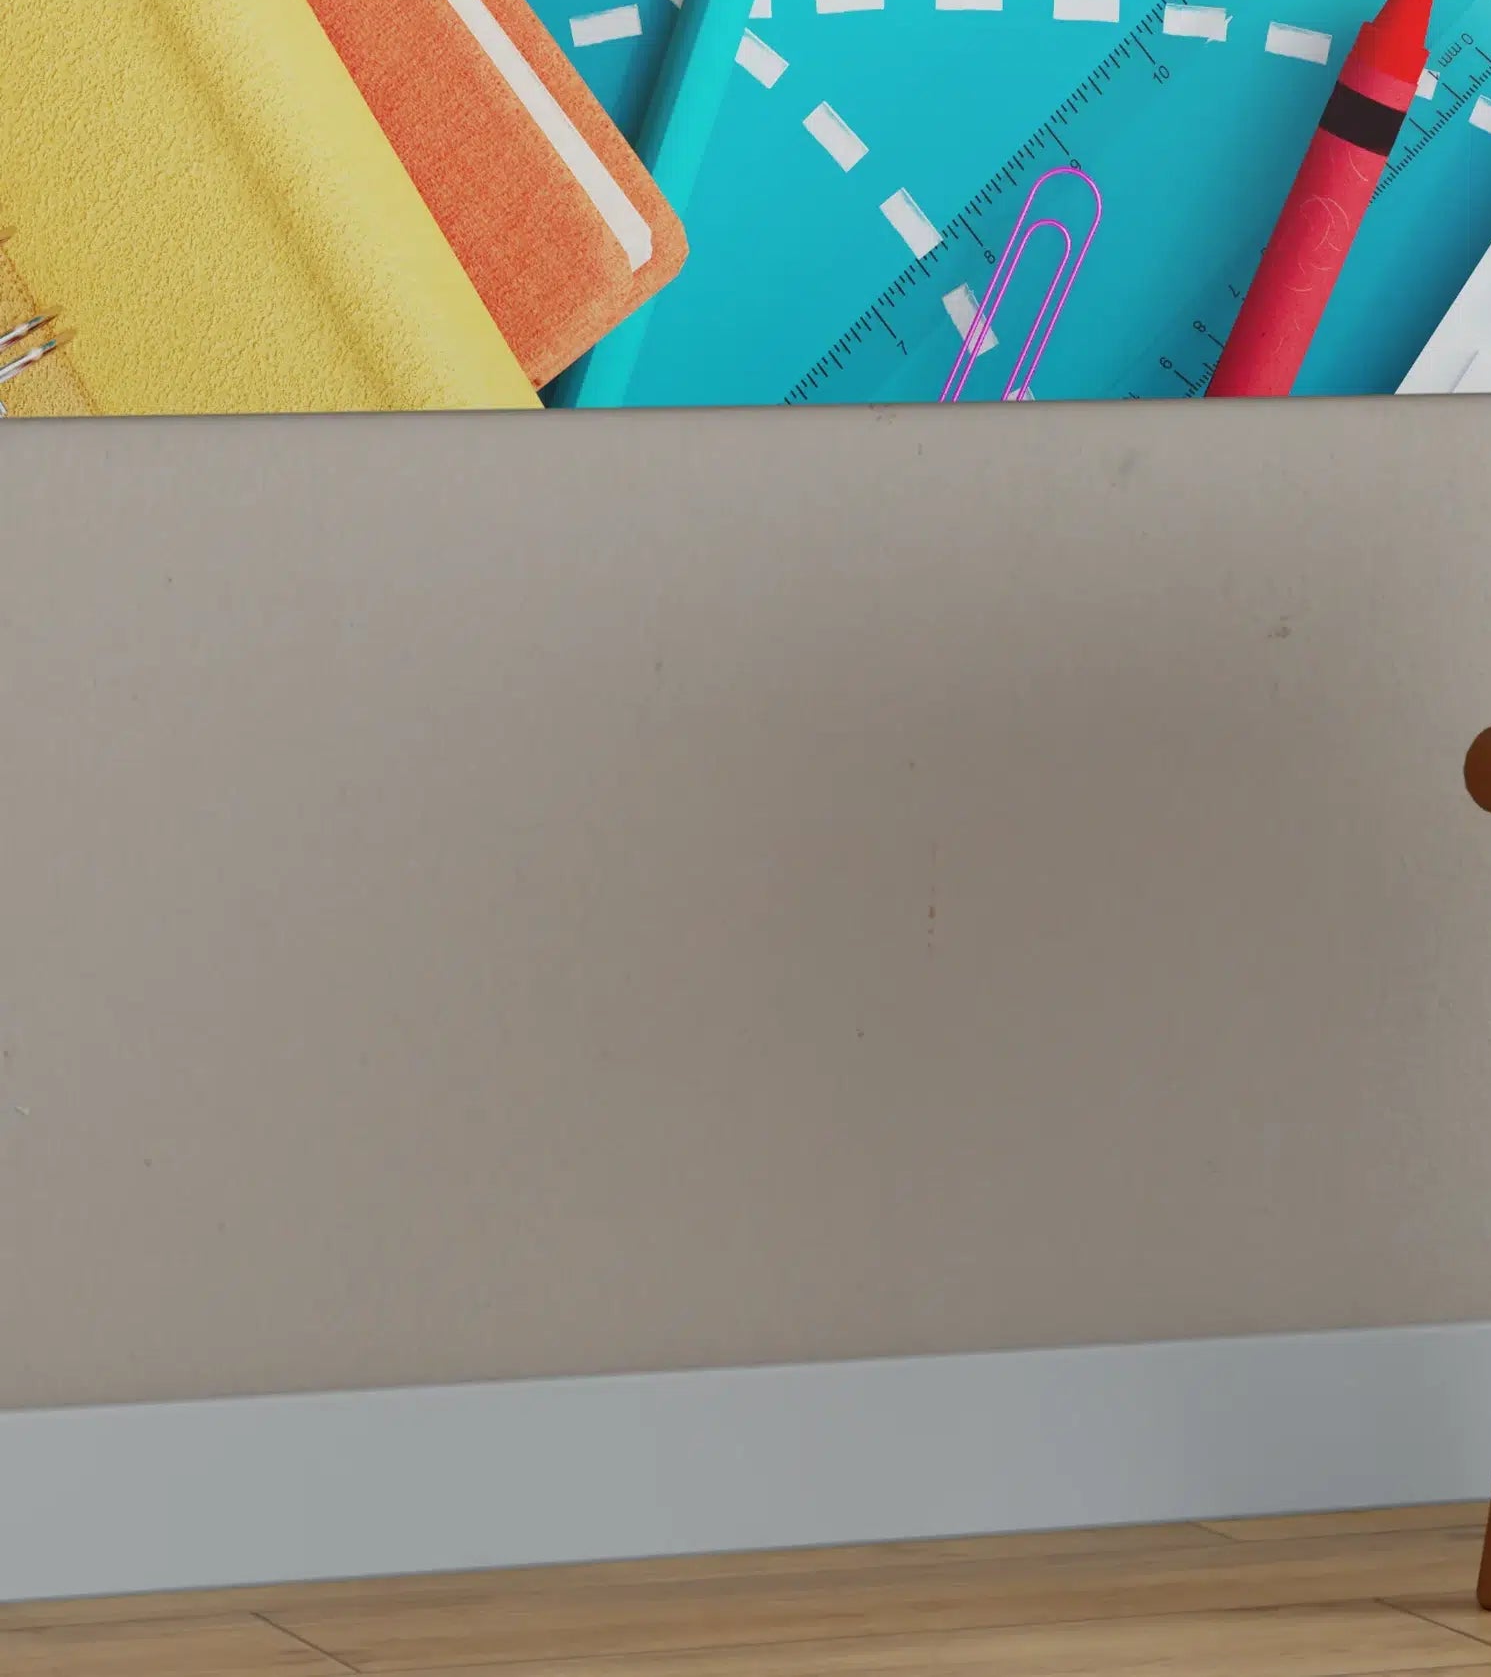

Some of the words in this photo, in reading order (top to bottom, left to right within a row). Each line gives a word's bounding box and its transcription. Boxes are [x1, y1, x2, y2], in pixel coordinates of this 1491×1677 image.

[1461, 33, 1474, 45] 0
[1438, 42, 1462, 67] mm
[1428, 70, 1439, 80] 1
[897, 340, 908, 355] 7
[984, 250, 996, 265] 8
[1153, 65, 1170, 84] 10
[1228, 284, 1240, 298] 7
[1193, 320, 1206, 333] 8
